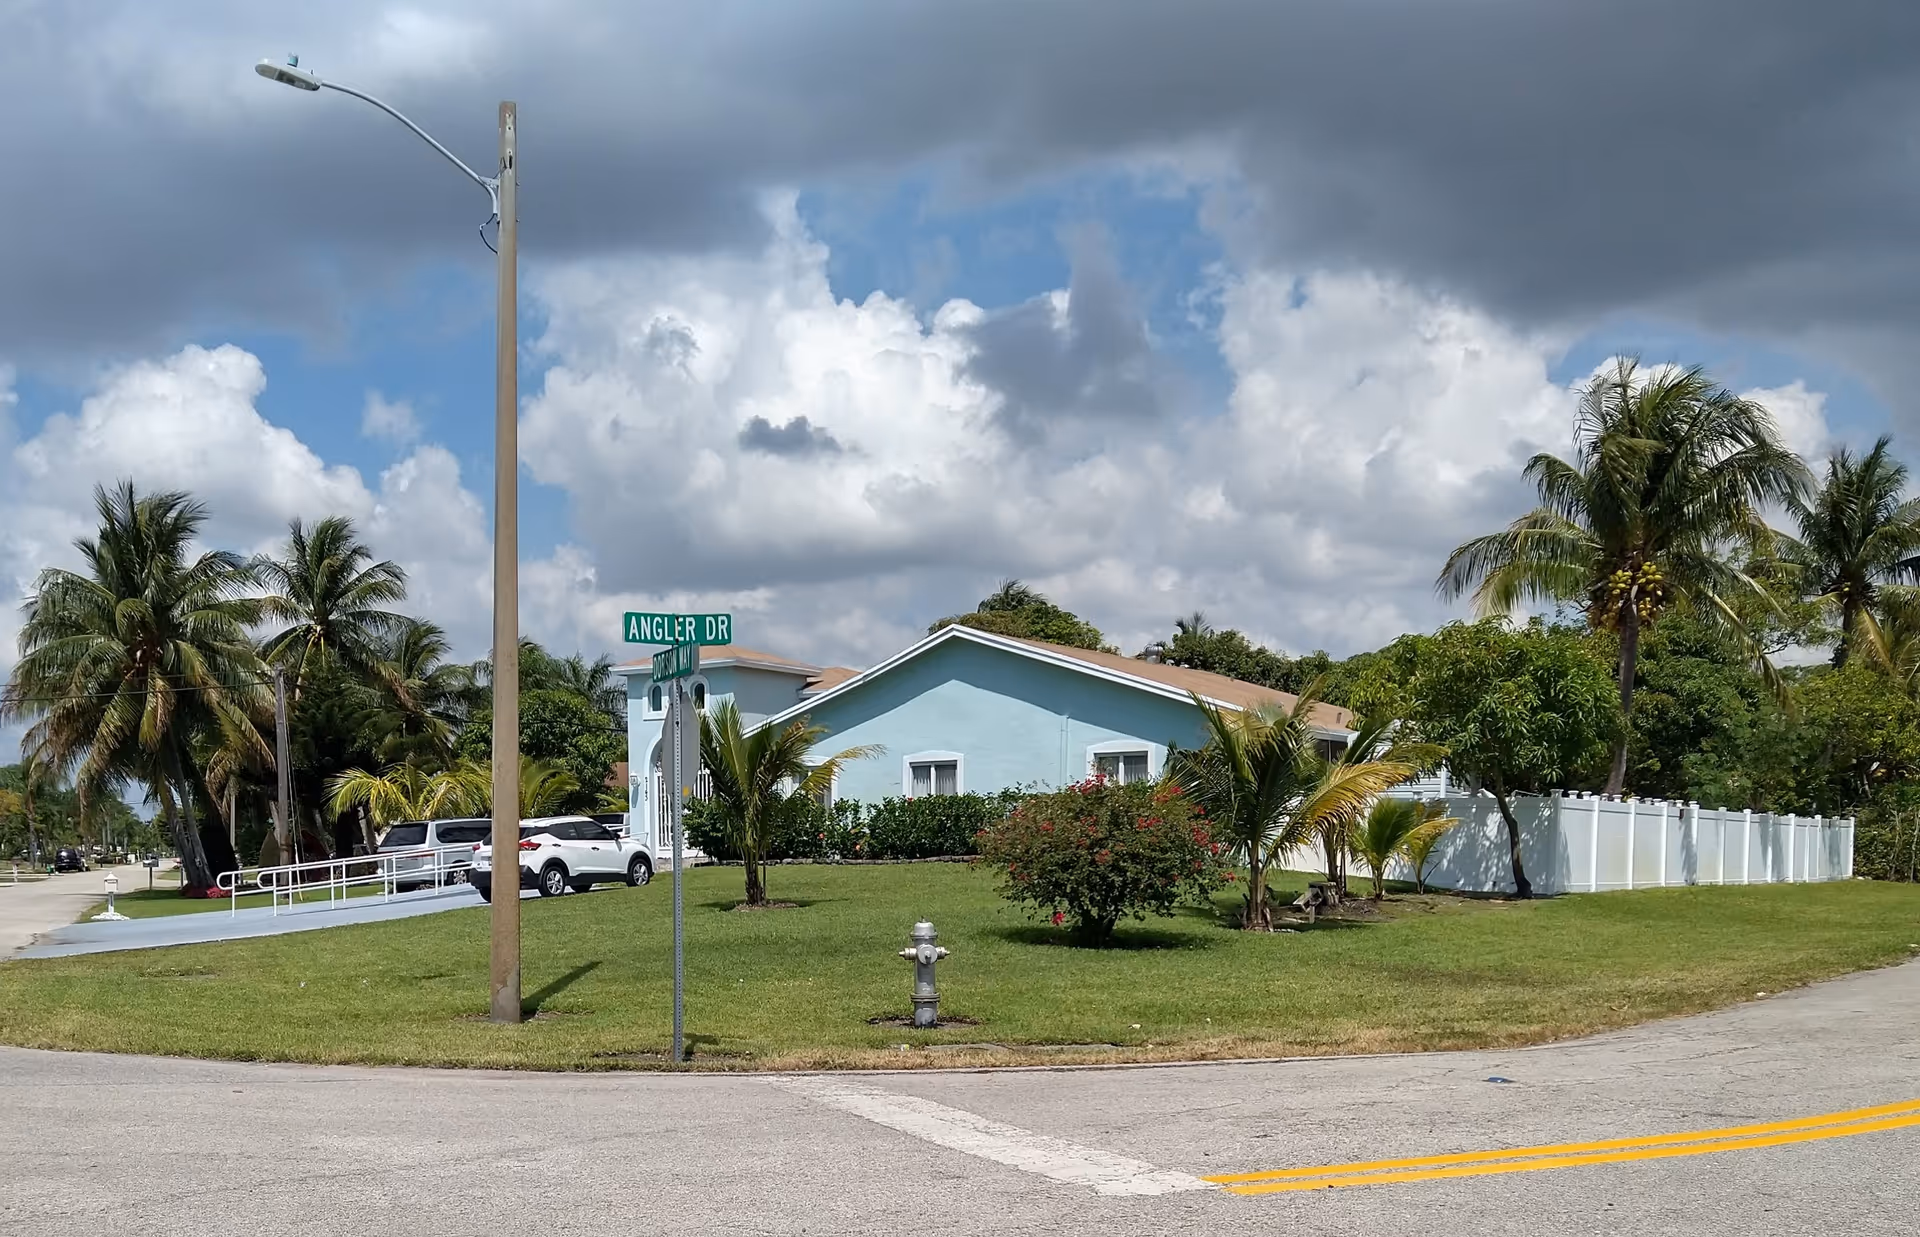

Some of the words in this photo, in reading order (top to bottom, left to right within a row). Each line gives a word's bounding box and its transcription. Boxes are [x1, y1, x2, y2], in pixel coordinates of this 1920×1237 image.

[629, 615, 696, 641] ANGLER
[706, 615, 729, 641] DR
[653, 648, 677, 680] DORSON
[678, 643, 691, 671] WAY
